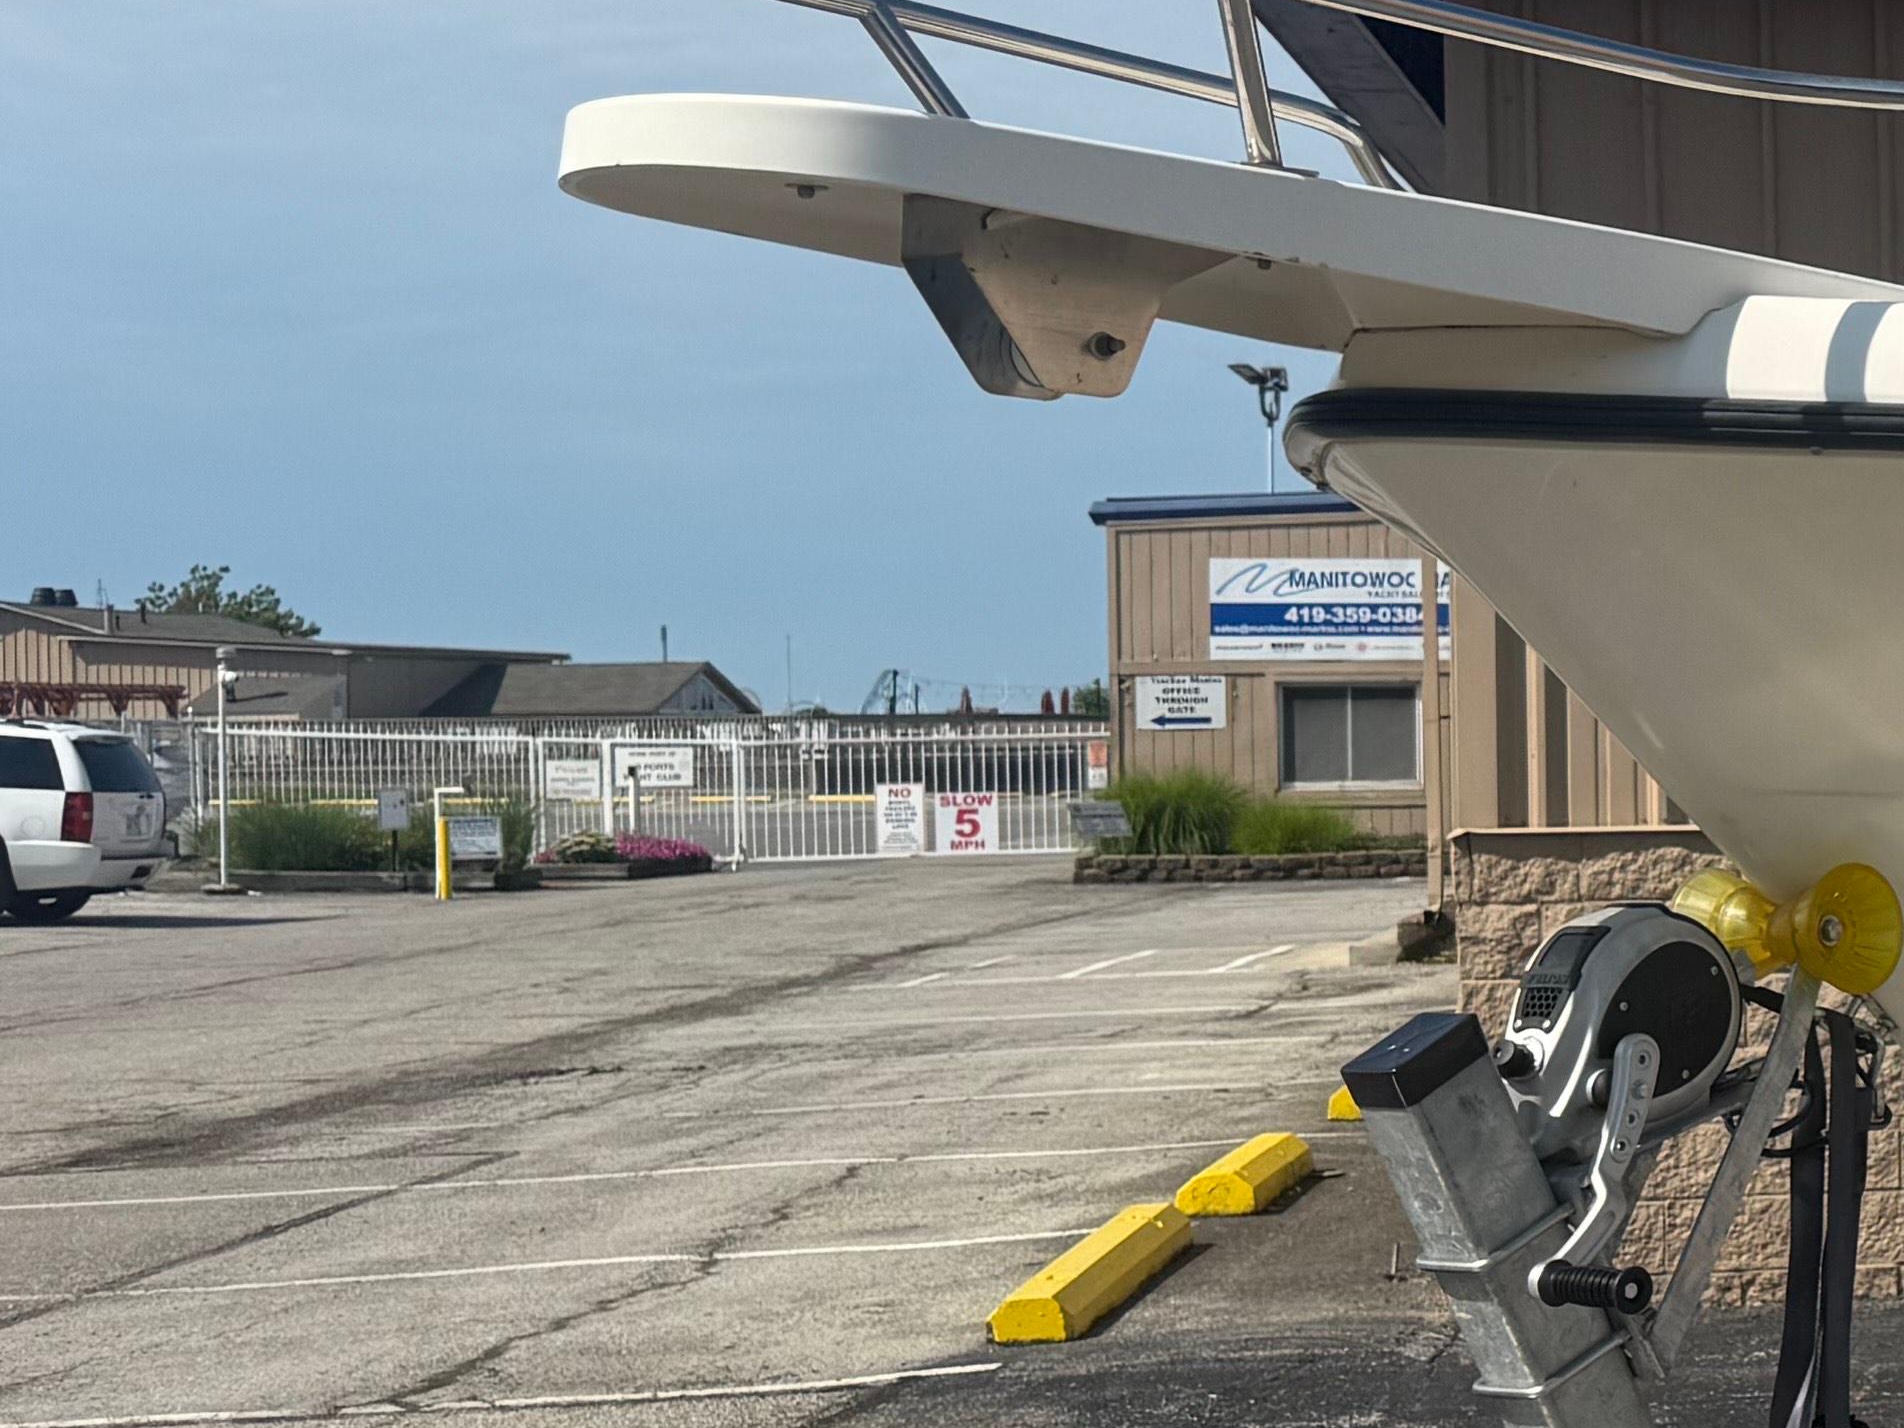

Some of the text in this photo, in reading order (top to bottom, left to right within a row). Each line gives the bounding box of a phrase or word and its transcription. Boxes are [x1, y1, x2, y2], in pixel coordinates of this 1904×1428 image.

[1288, 571, 1416, 589] MANITOWOC
[888, 788, 911, 798] NO
[940, 794, 993, 807] SLOW
[955, 808, 981, 838] 5
[950, 840, 985, 851] MPH
